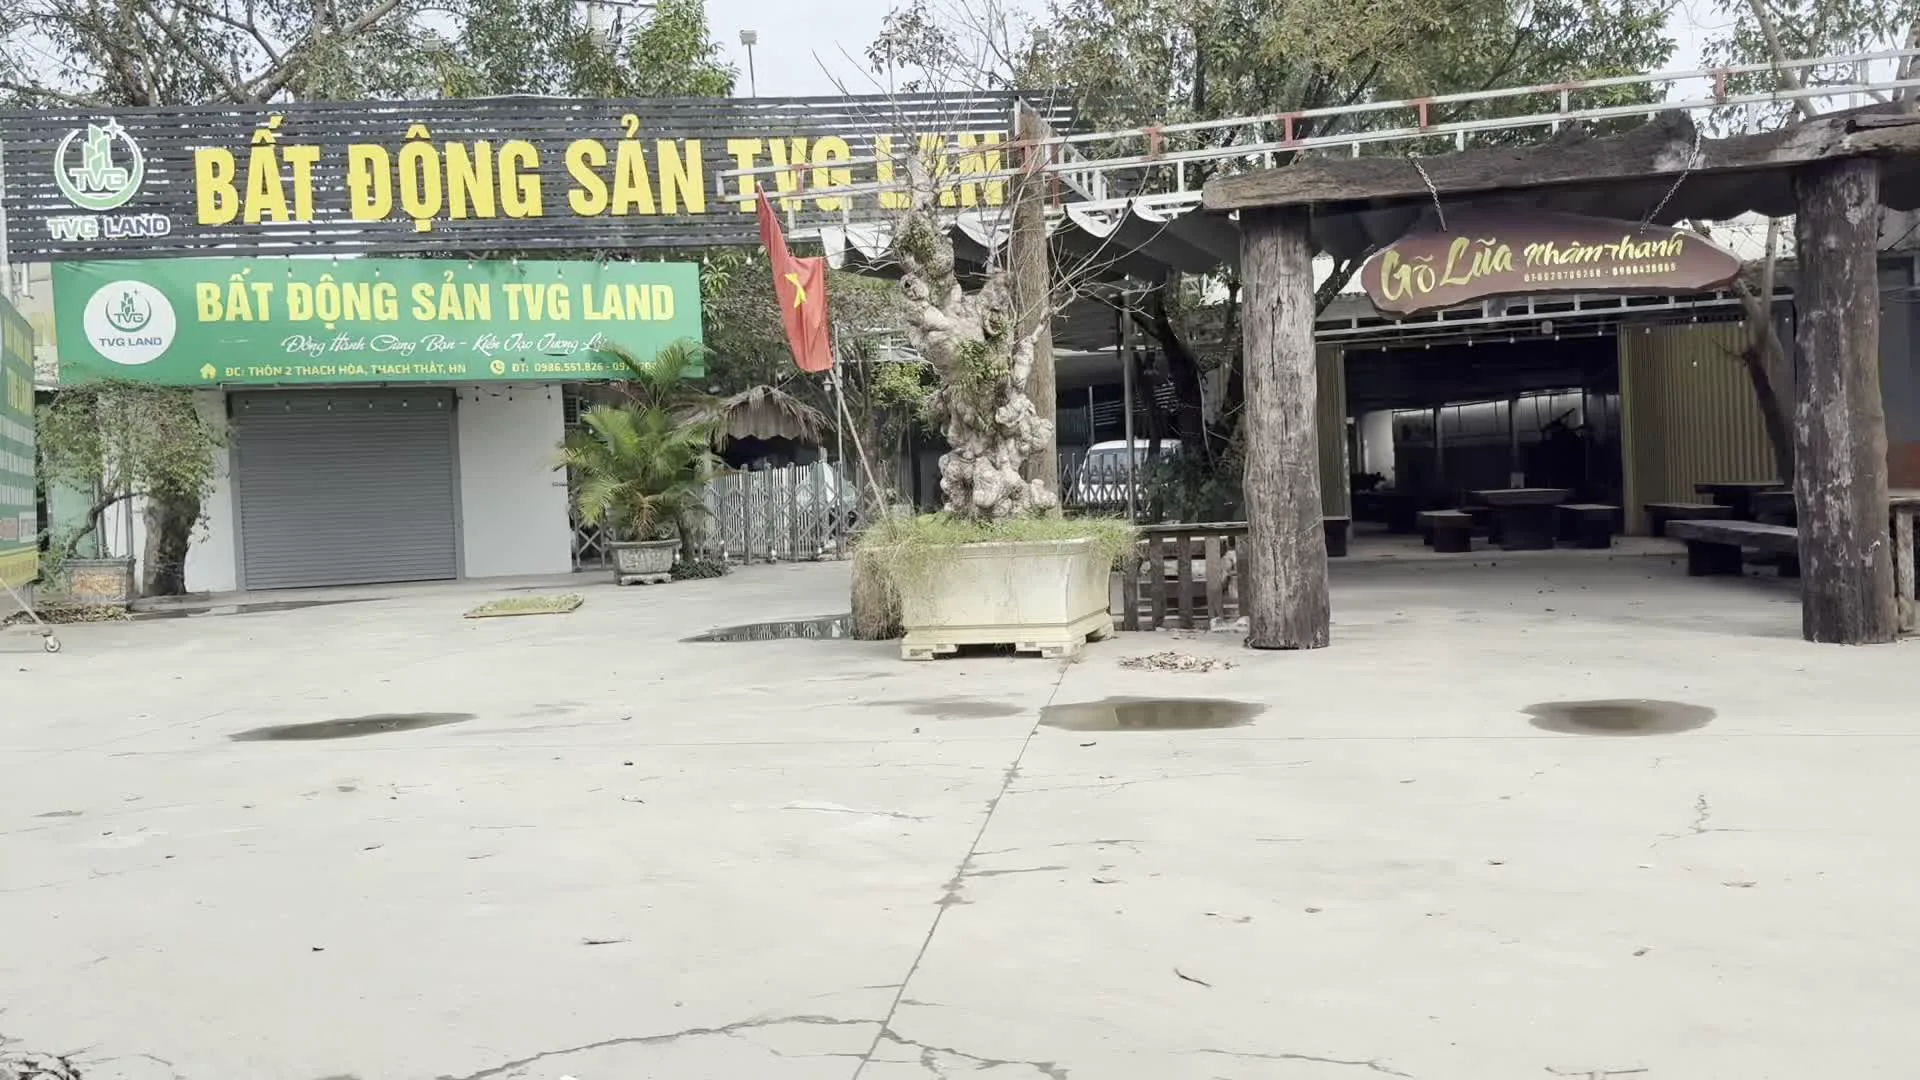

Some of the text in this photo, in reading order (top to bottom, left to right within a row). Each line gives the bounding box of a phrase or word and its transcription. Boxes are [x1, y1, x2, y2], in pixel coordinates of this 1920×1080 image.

[69, 168, 128, 191] TVG
[195, 114, 1003, 232] BẤT ĐỘNG SẢN TVG LAN
[47, 215, 170, 239] TVG LAND
[196, 268, 674, 330] BẤT ĐỘNG SẢN TVG LAND
[113, 313, 144, 323] TVG
[99, 337, 162, 347] TVG LAND
[370, 334, 416, 357] Cùng
[248, 364, 282, 377] THÔN
[284, 366, 293, 376] 2
[448, 363, 467, 374] HN
[534, 363, 603, 373] 0986.551.826
